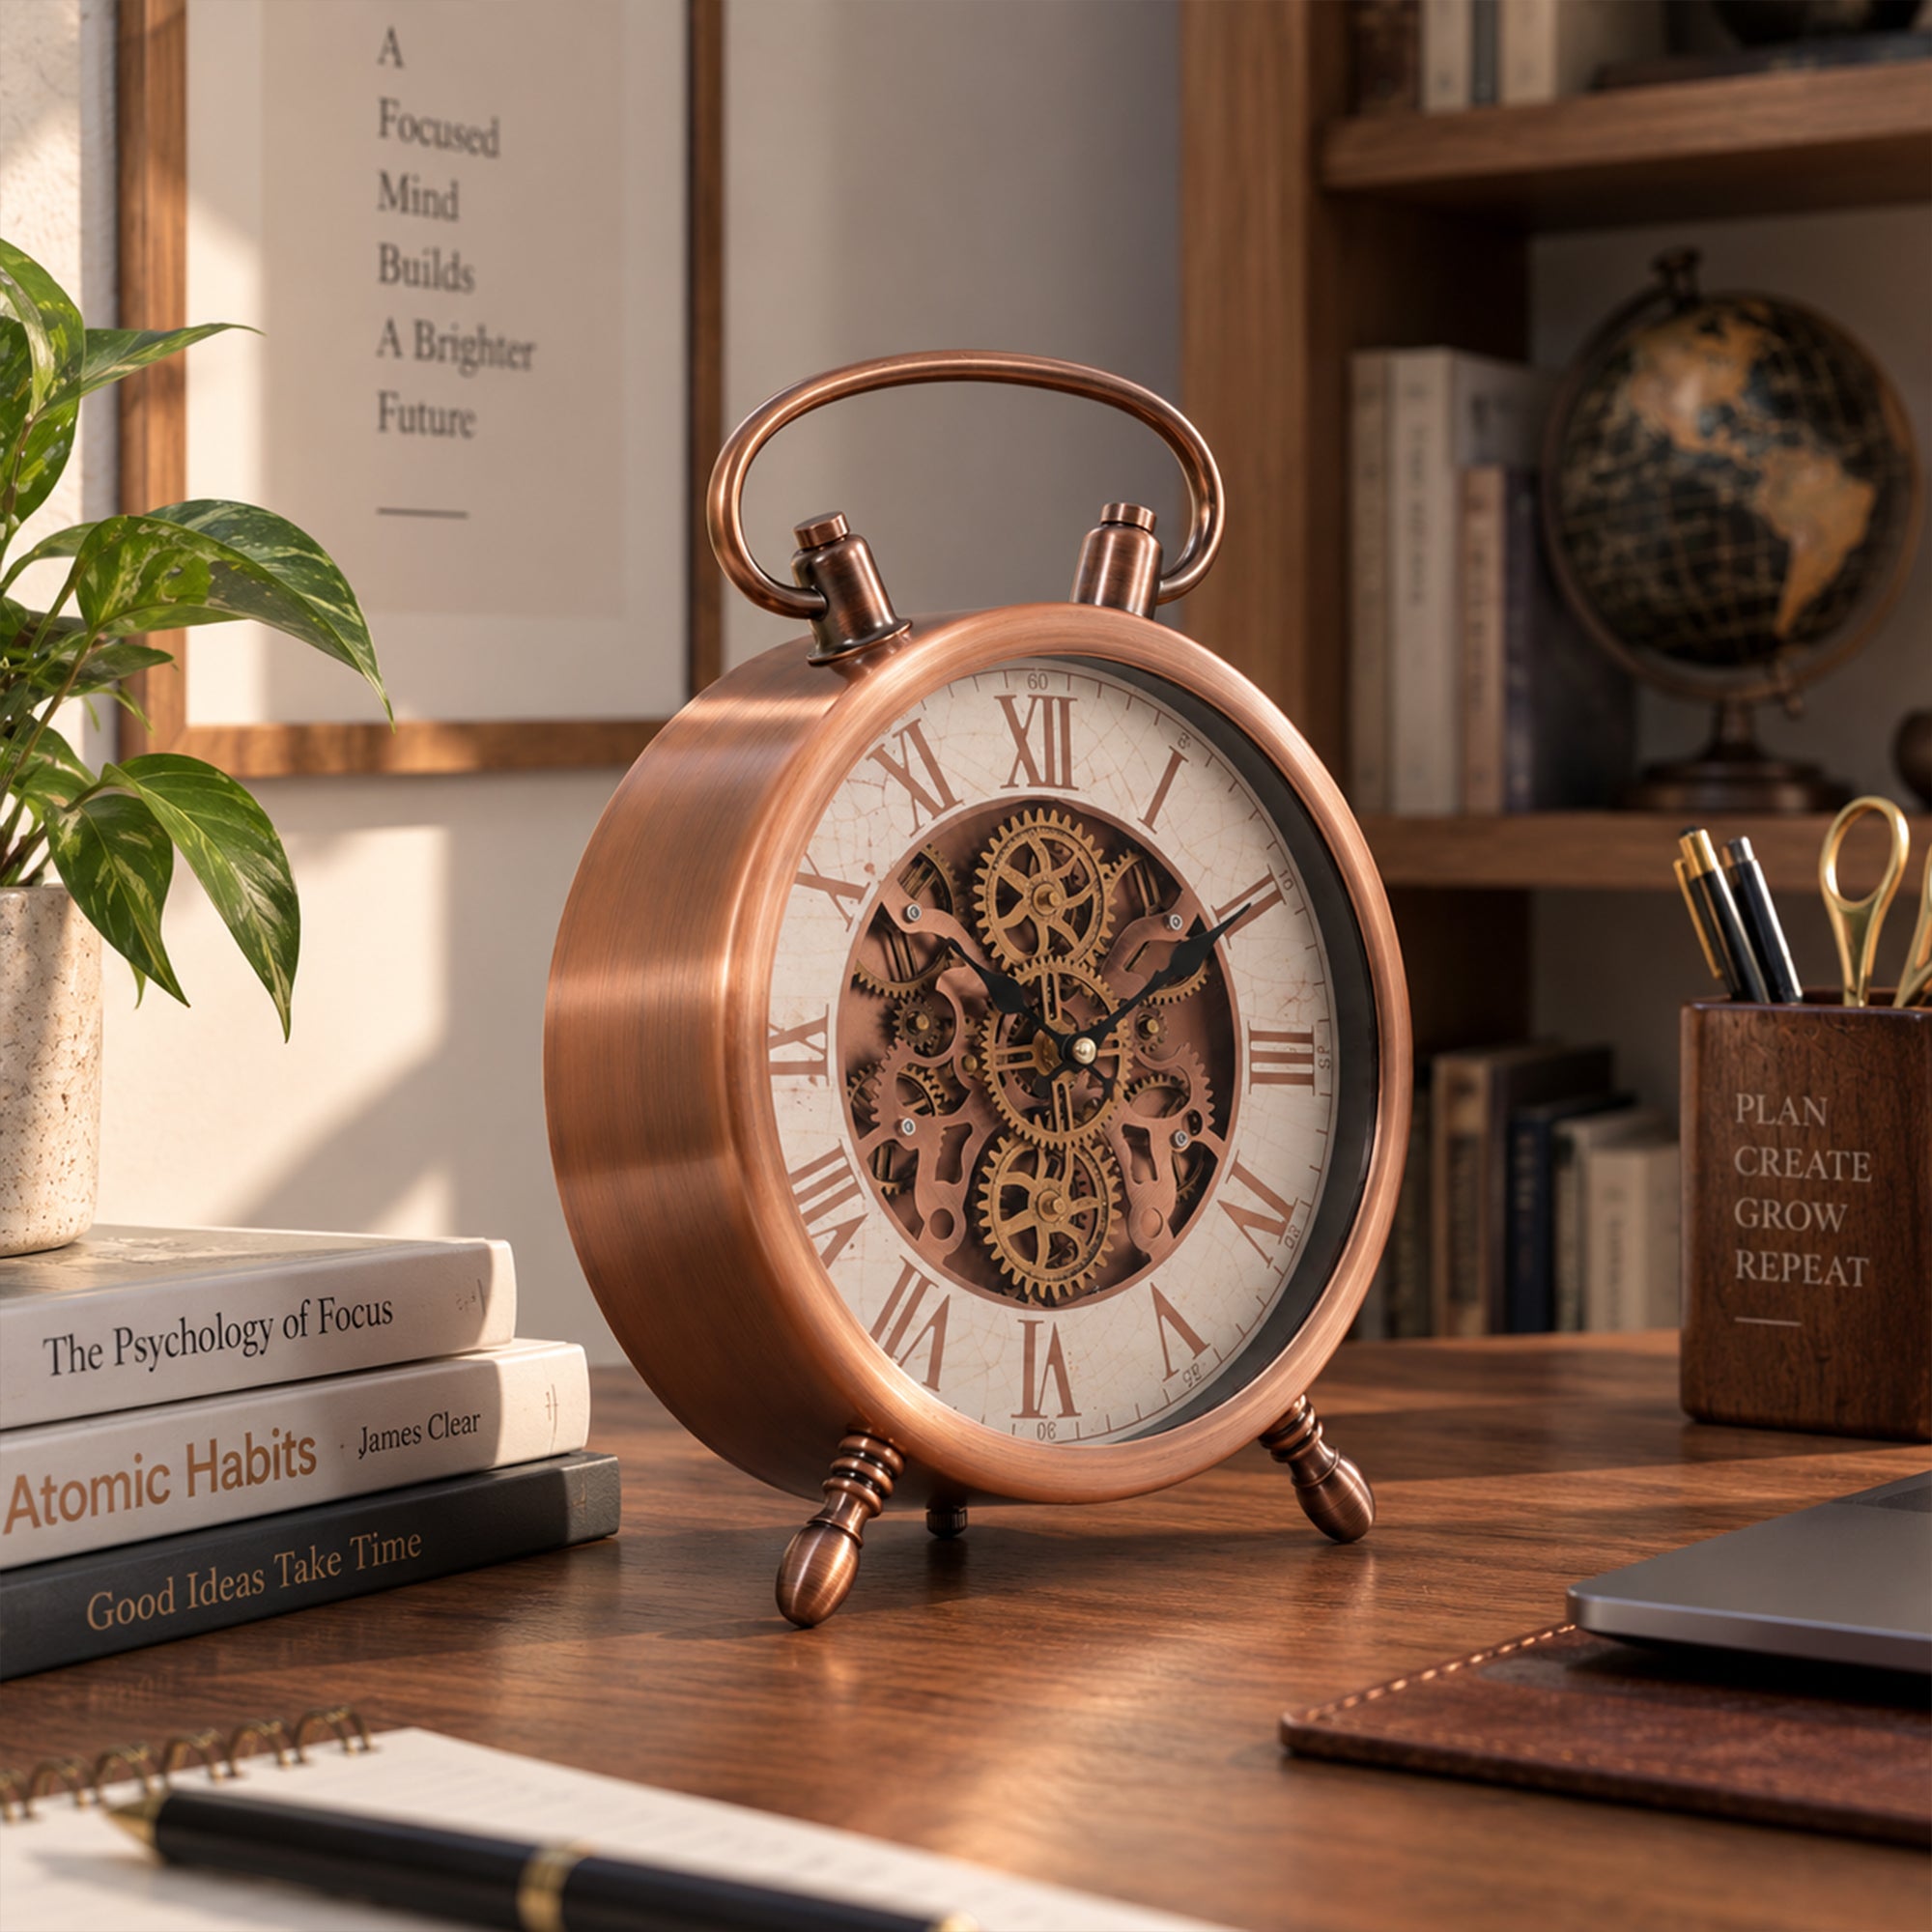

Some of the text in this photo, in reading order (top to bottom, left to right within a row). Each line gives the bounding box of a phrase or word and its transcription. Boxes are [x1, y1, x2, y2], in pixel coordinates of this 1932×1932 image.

[377, 25, 404, 69] A
[378, 96, 499, 158] Focused
[378, 169, 459, 221] Mind
[378, 242, 475, 294] Builds
[376, 316, 537, 378] A Brighter
[377, 389, 476, 440] Future
[994, 695, 1078, 791] XII
[866, 718, 964, 838] XI
[1137, 746, 1189, 835] I
[1247, 1021, 1316, 1096] III
[1735, 1093, 1828, 1126] PLAN
[1734, 1146, 1872, 1182] CREATE
[1217, 1150, 1298, 1268] IV
[1734, 1197, 1848, 1233] GROW
[1735, 1249, 1870, 1288] REPEAT
[43, 1295, 394, 1377] The Psychology of Focus
[1150, 1282, 1210, 1382] V
[1010, 1320, 1082, 1418] VI
[357, 1409, 481, 1460] James Clear
[3, 1429, 318, 1535] Atomic Habits
[86, 1529, 422, 1631] Good Ideas Take Time
